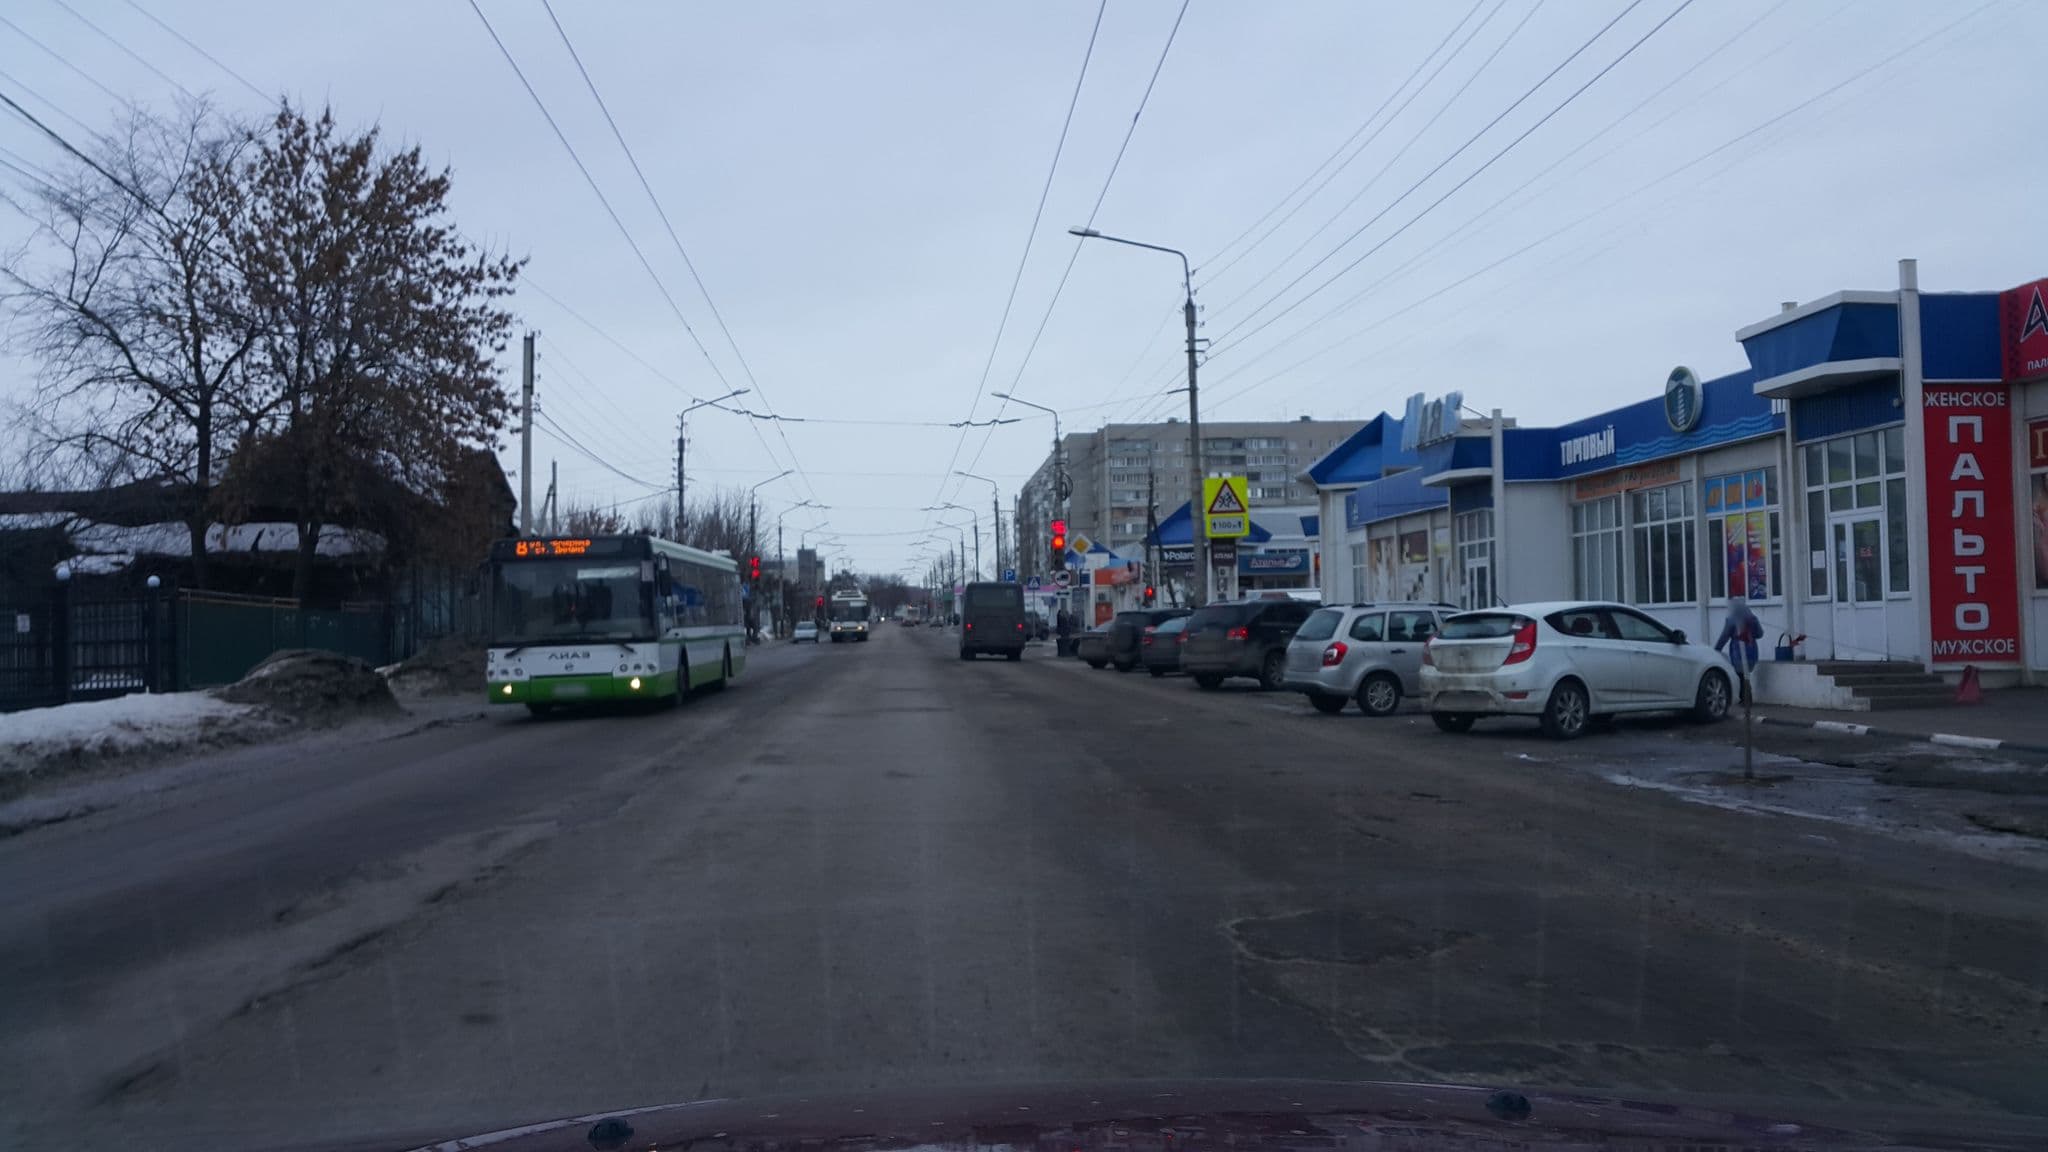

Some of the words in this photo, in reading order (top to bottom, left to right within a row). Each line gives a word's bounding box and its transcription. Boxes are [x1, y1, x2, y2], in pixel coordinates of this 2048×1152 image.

[2027, 357, 2048, 370] ПАЛ
[1924, 391, 2005, 407] ЖЕНСКОЕ
[1561, 424, 1615, 466] ТОРГОВЫЙ
[1948, 415, 1990, 631] ПАЛЬТО
[1932, 638, 2015, 655] МУЖСКОЕ
